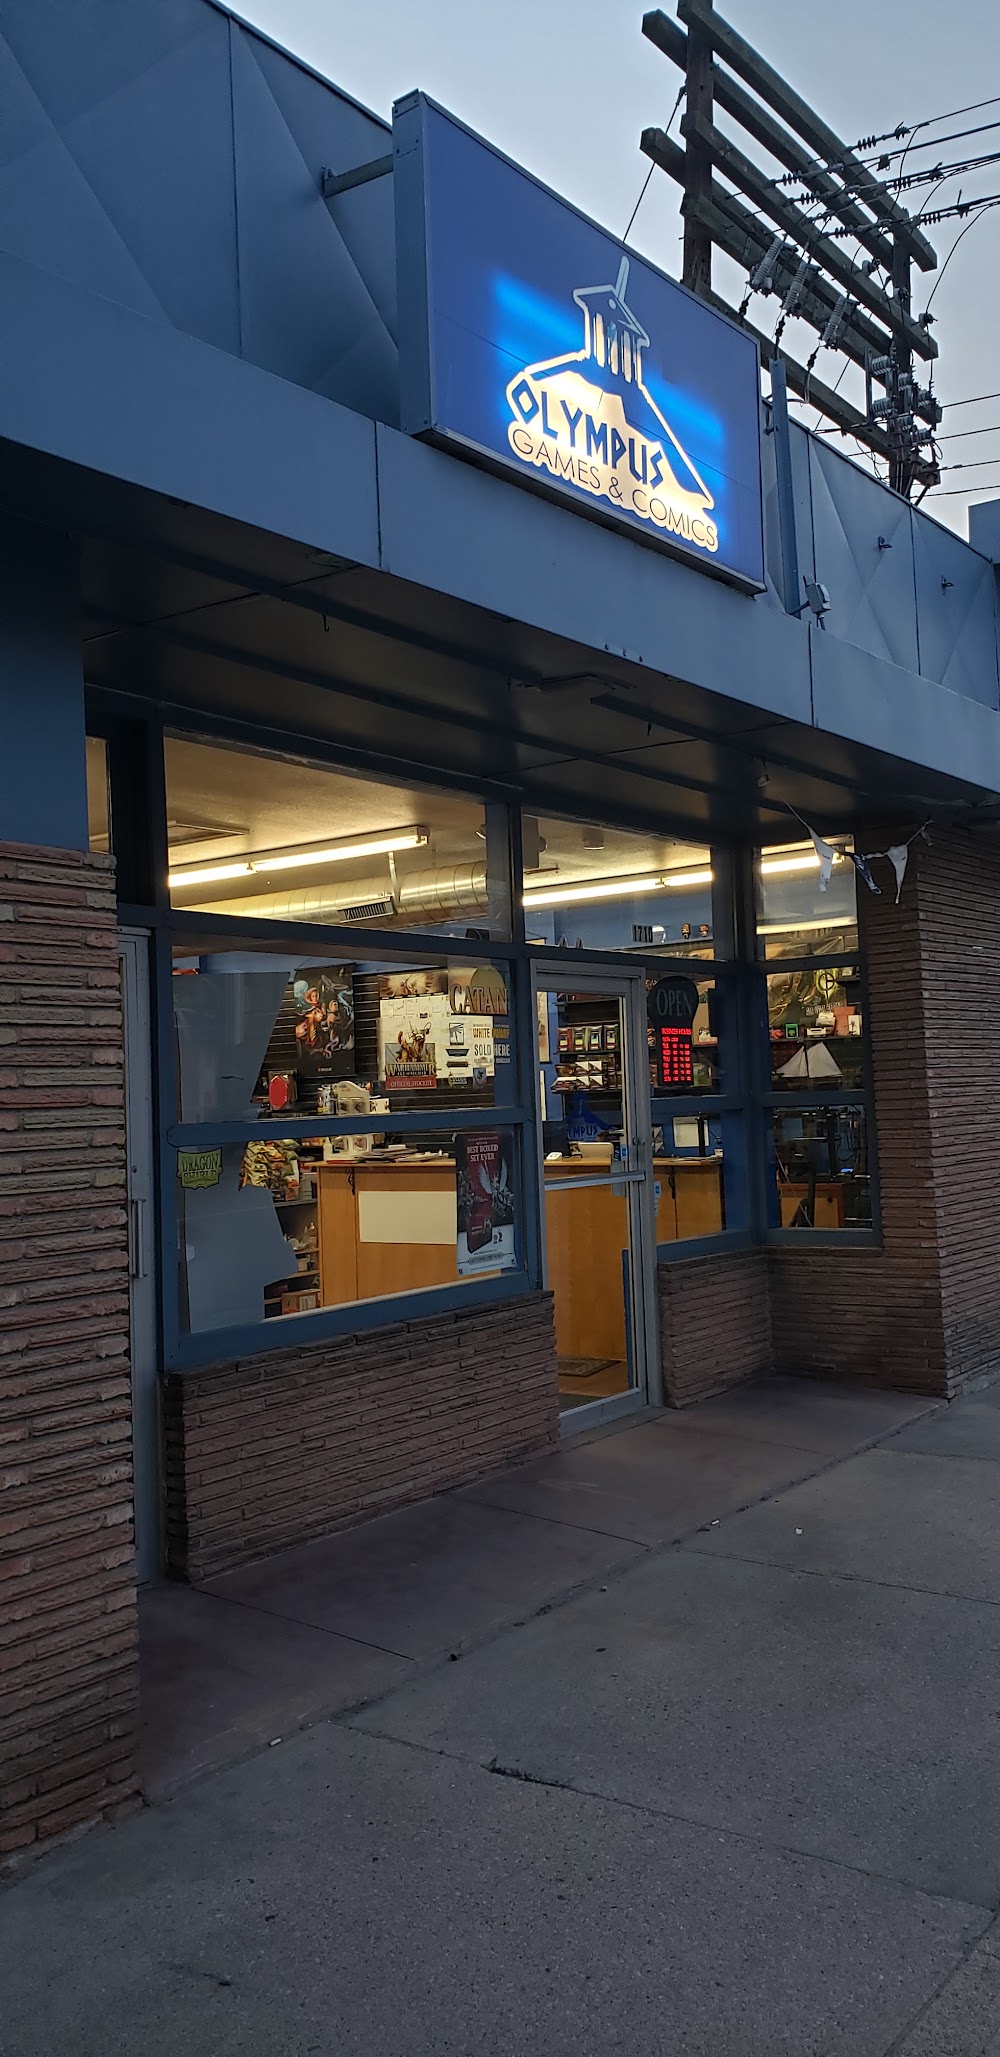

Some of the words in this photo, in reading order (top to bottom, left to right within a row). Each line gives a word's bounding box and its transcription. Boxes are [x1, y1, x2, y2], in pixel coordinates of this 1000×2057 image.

[511, 378, 664, 490] OLYMPUS
[512, 428, 601, 489] GAMES
[608, 476, 624, 502] &
[632, 489, 716, 547] COMICS
[633, 925, 653, 943] 1710
[449, 983, 508, 1015] CATAN
[656, 988, 692, 1017] OPEN
[472, 1027, 491, 1039] WHITE
[474, 1043, 492, 1056] SOLD
[493, 1043, 510, 1056] HERE
[466, 1145, 479, 1154] BEST
[479, 1144, 499, 1153] BOXED
[470, 1154, 480, 1162] SET
[480, 1152, 496, 1161] EVER
[181, 1152, 219, 1172] DRAGON
